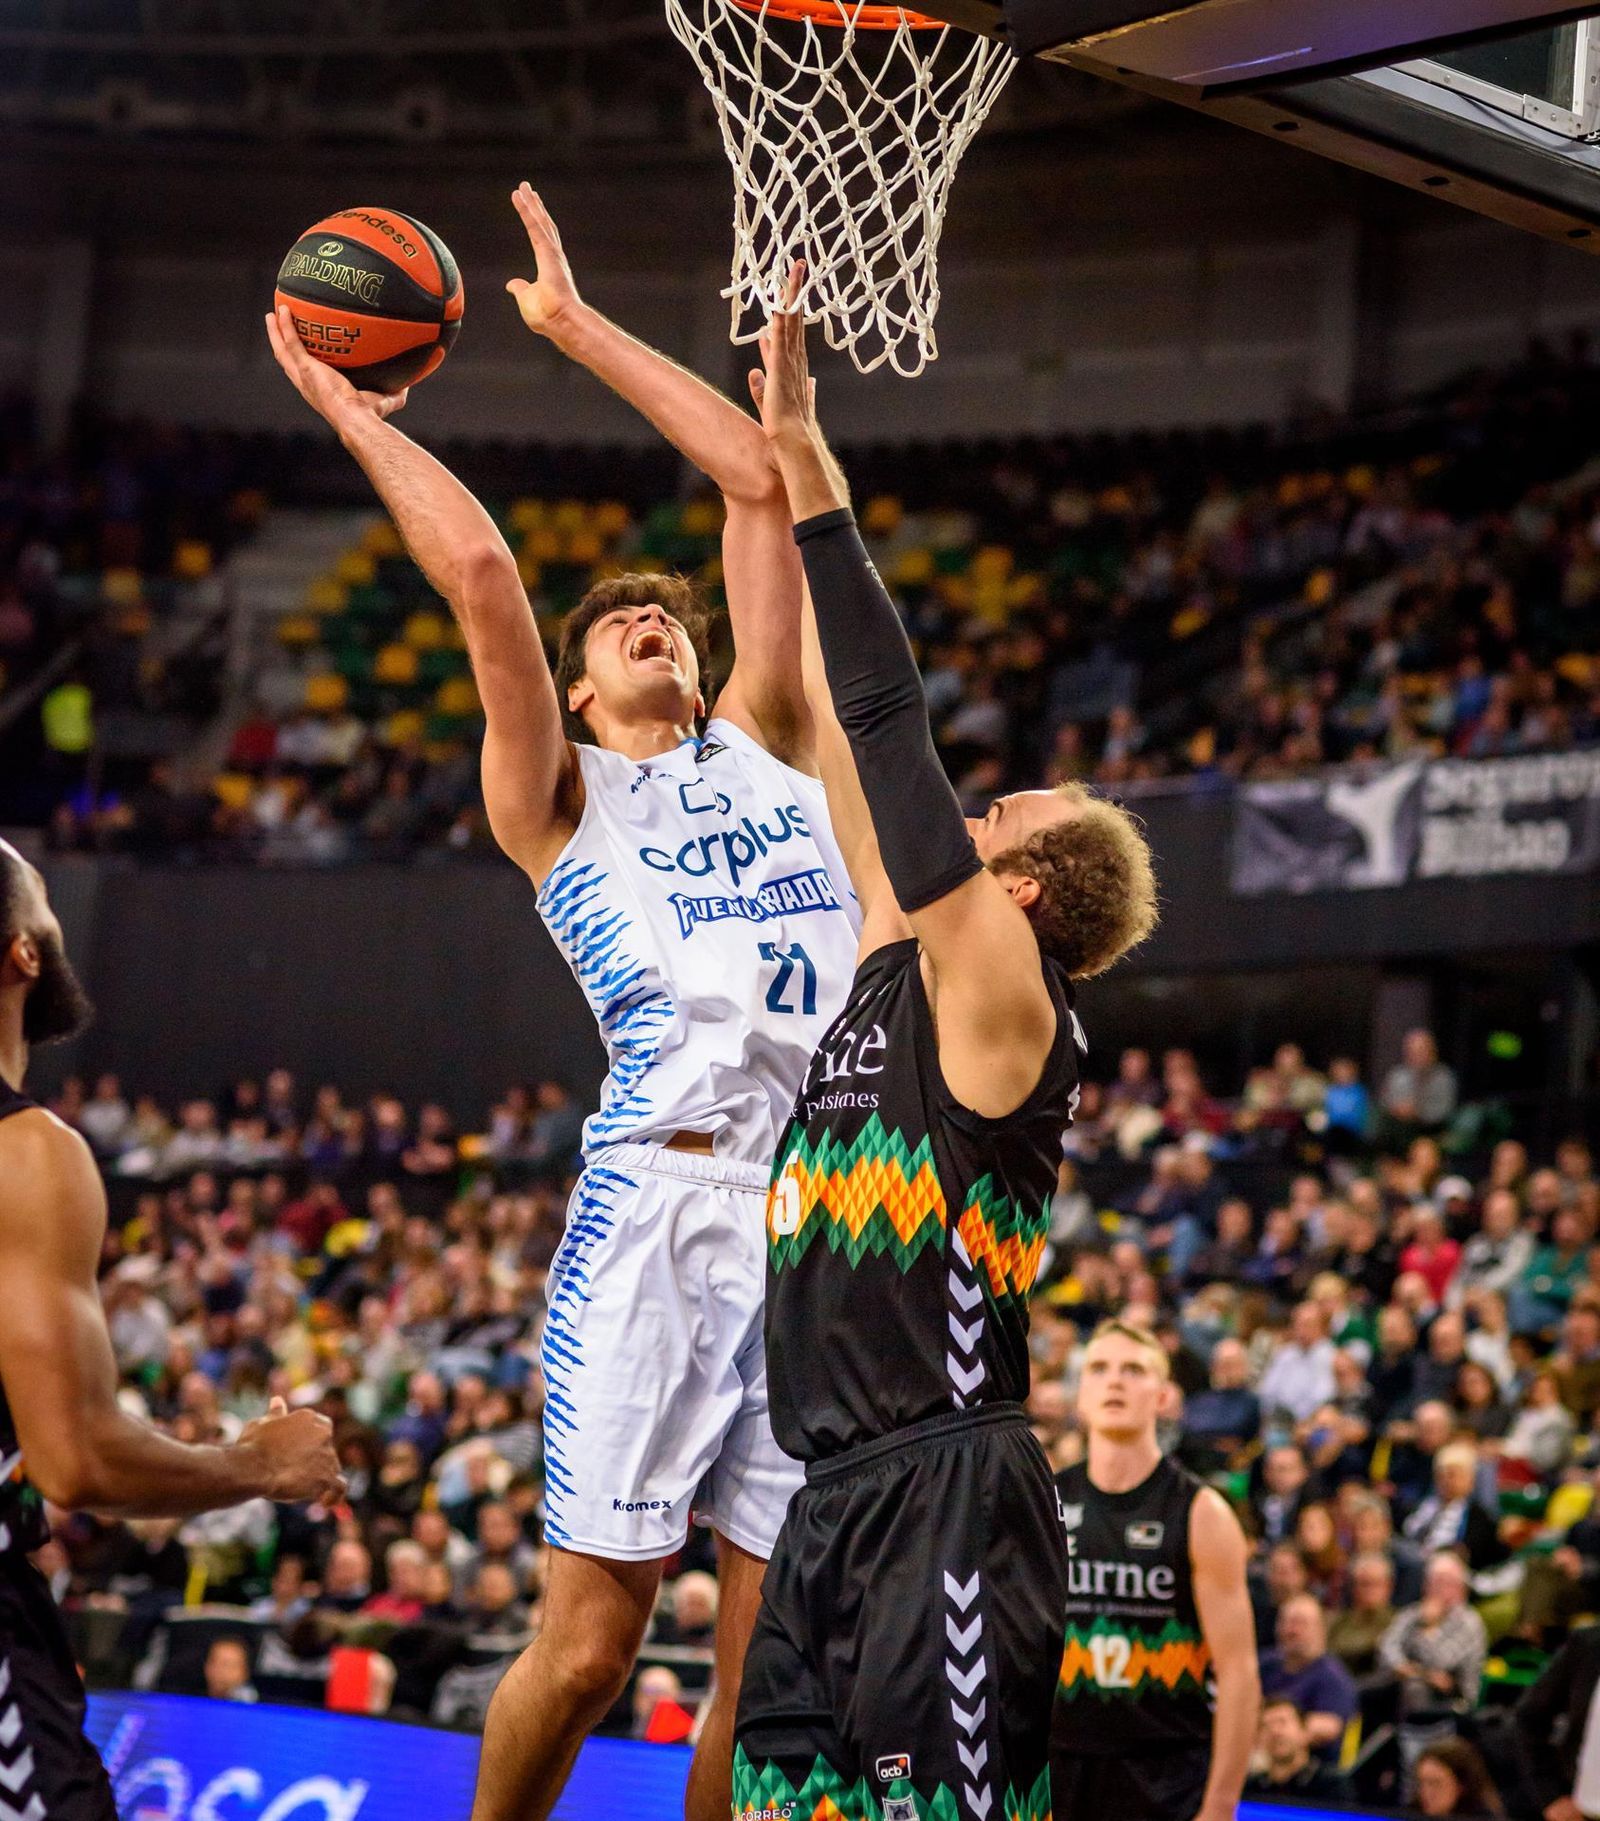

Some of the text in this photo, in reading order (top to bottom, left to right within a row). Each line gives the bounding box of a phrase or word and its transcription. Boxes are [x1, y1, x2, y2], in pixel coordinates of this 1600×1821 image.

[341, 210, 418, 258] endesa
[284, 250, 385, 305] PALDING
[295, 317, 362, 344] GACY
[639, 805, 812, 888] carplus
[668, 868, 841, 940] FUENLRADA
[758, 942, 817, 1015] 21
[612, 1498, 672, 1512] Kromex
[1068, 1559, 1177, 1600] urne
[1088, 1633, 1133, 1688] 12
[880, 1765, 903, 1778] acb
[741, 1807, 792, 1821] CORREO
